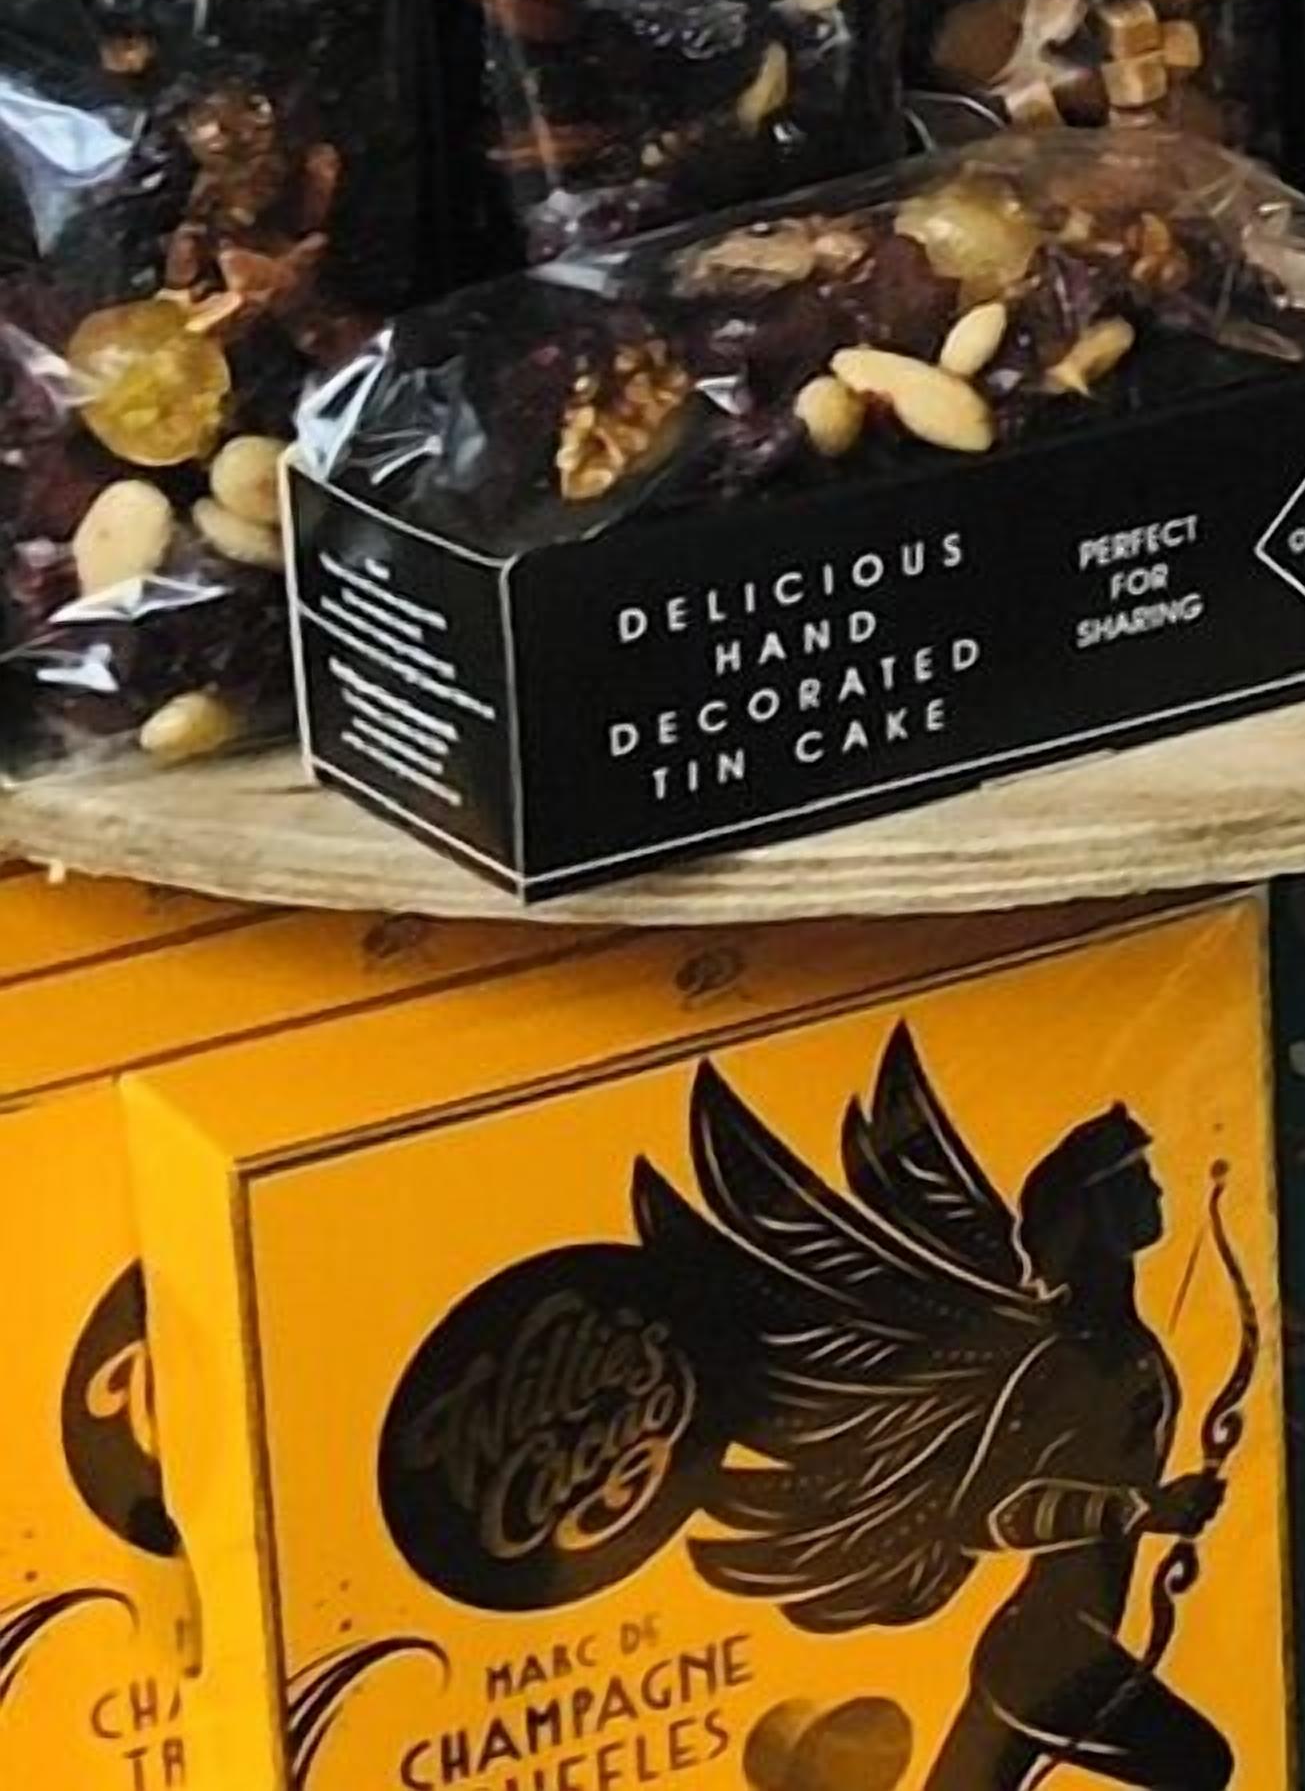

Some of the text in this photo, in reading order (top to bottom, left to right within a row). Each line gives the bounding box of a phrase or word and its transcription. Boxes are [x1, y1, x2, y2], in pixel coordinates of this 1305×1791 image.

[1078, 514, 1199, 571] PERFECT
[1110, 562, 1169, 601] FOR
[618, 532, 962, 644] DELICIOUS
[1075, 592, 1204, 650] SHARING
[715, 610, 877, 676] HAND
[609, 638, 980, 757] DECORATED
[652, 698, 947, 800] TIN CAKE
[486, 1613, 660, 1703] MARC DE
[400, 1634, 754, 1791] CHAMPAGNE
